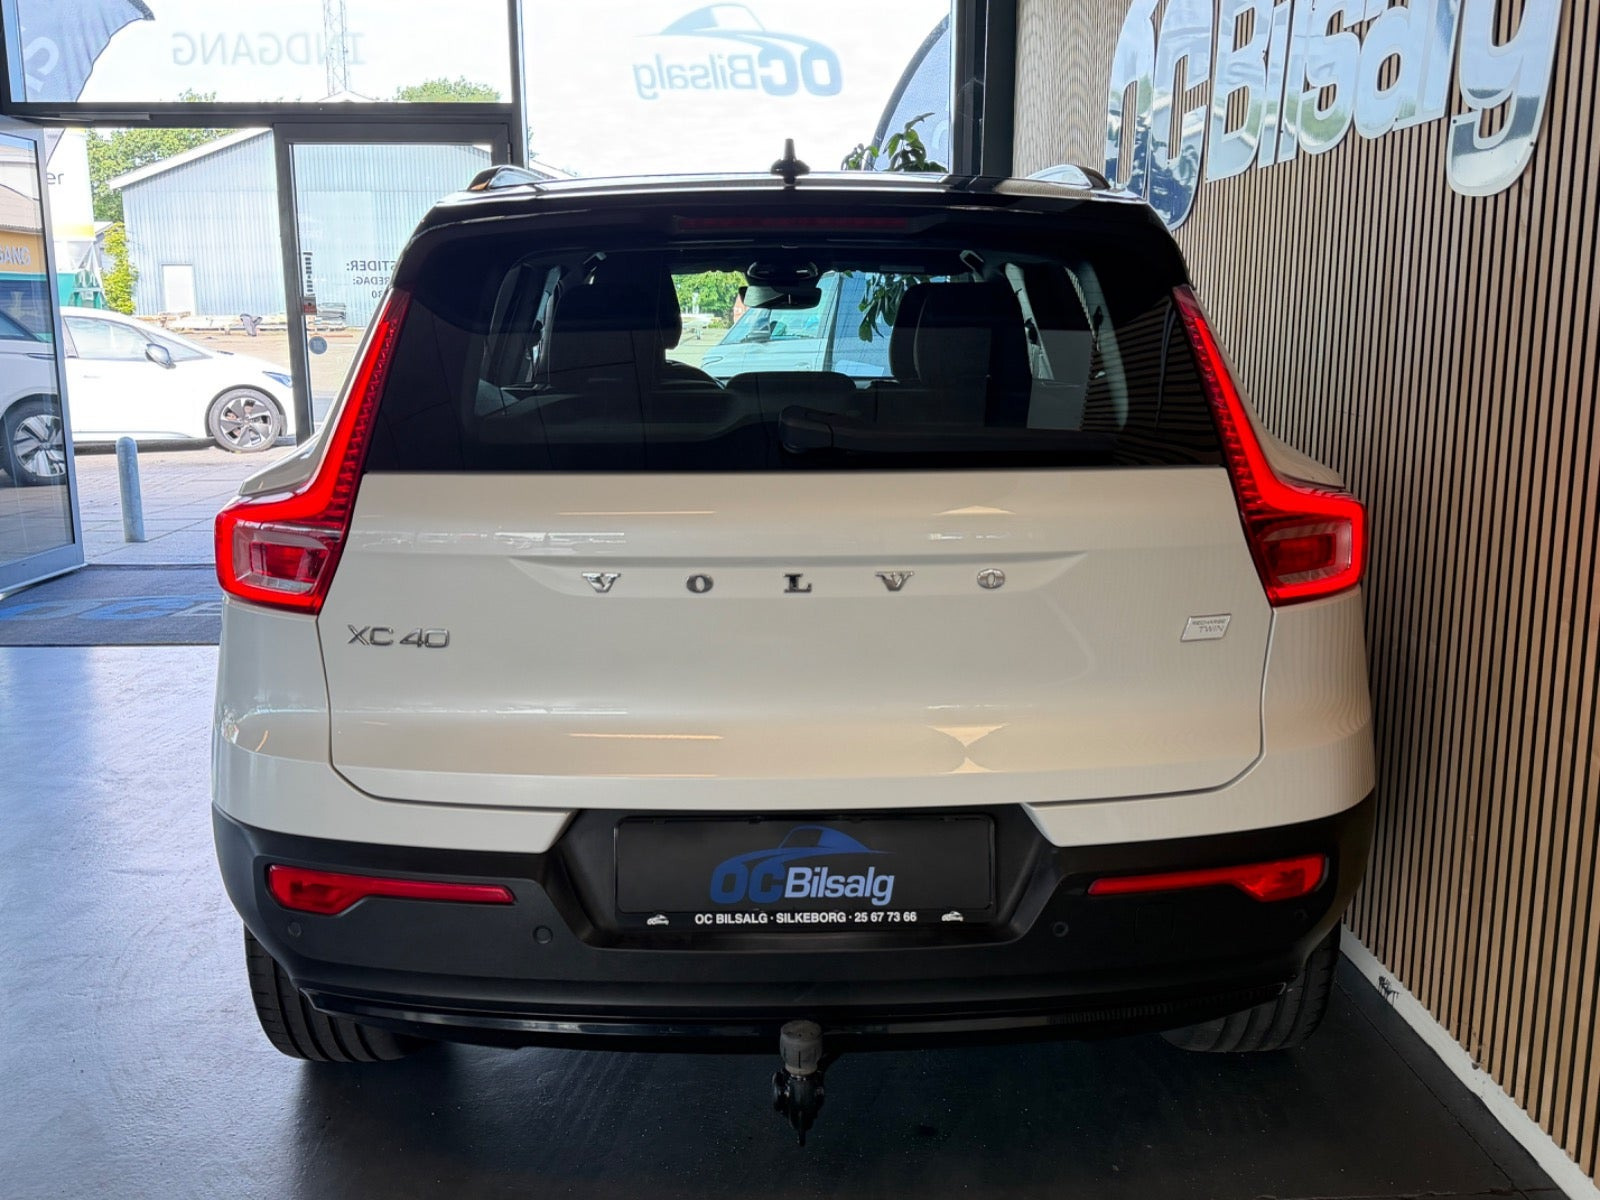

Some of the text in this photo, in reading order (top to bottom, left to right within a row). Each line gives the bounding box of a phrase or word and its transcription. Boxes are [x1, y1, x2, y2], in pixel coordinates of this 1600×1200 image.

[581, 568, 1007, 593] VOLVO
[347, 624, 450, 648] XC 40
[695, 911, 917, 925] OC BILSALG SILKEBORG 25 67 73 66
